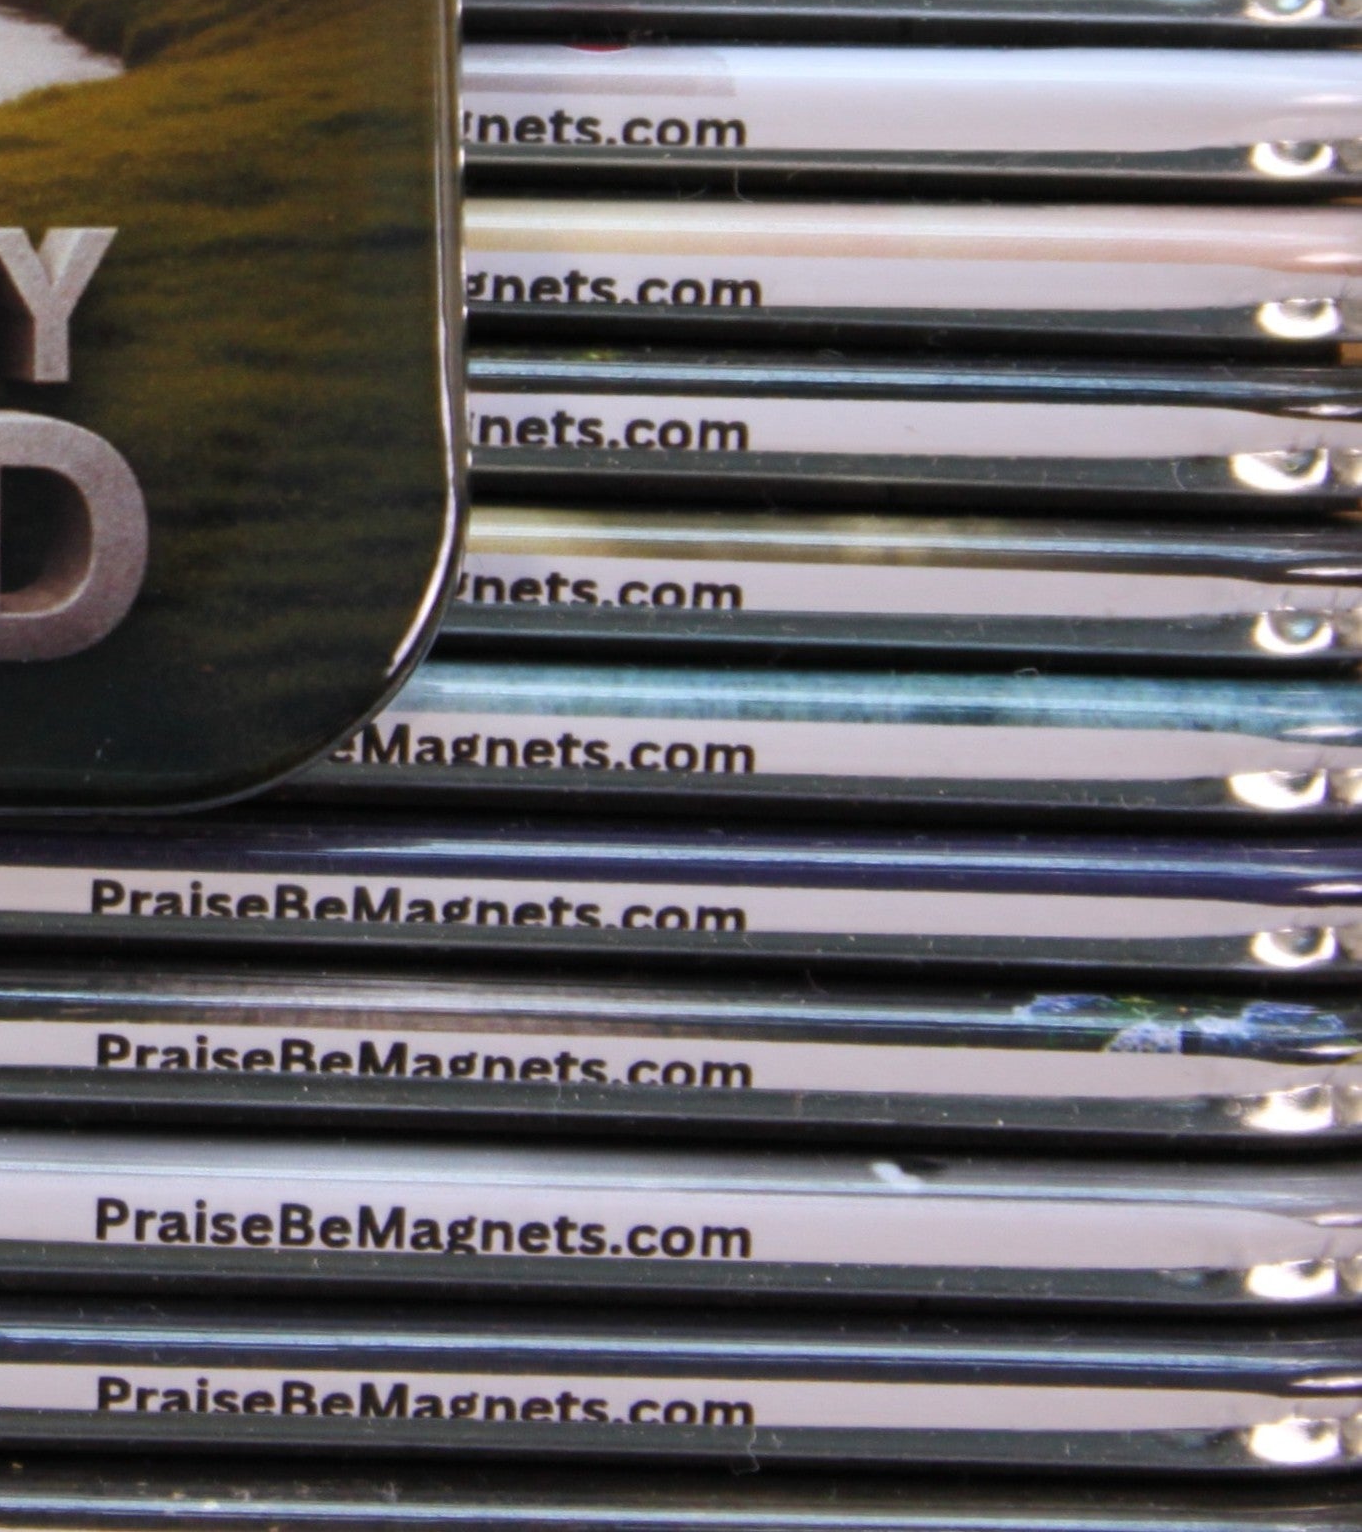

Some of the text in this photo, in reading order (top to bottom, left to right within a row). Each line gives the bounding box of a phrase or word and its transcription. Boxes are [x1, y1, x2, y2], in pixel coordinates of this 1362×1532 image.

[328, 722, 754, 774] eMagnets.com
[92, 879, 746, 932] PraiseBeMagnets.com
[98, 1034, 752, 1089] PraiseBeMagnets.com
[96, 1198, 751, 1259] PraiseBeMagnets.com
[98, 1376, 754, 1425] PraiseBeMagnets.com
